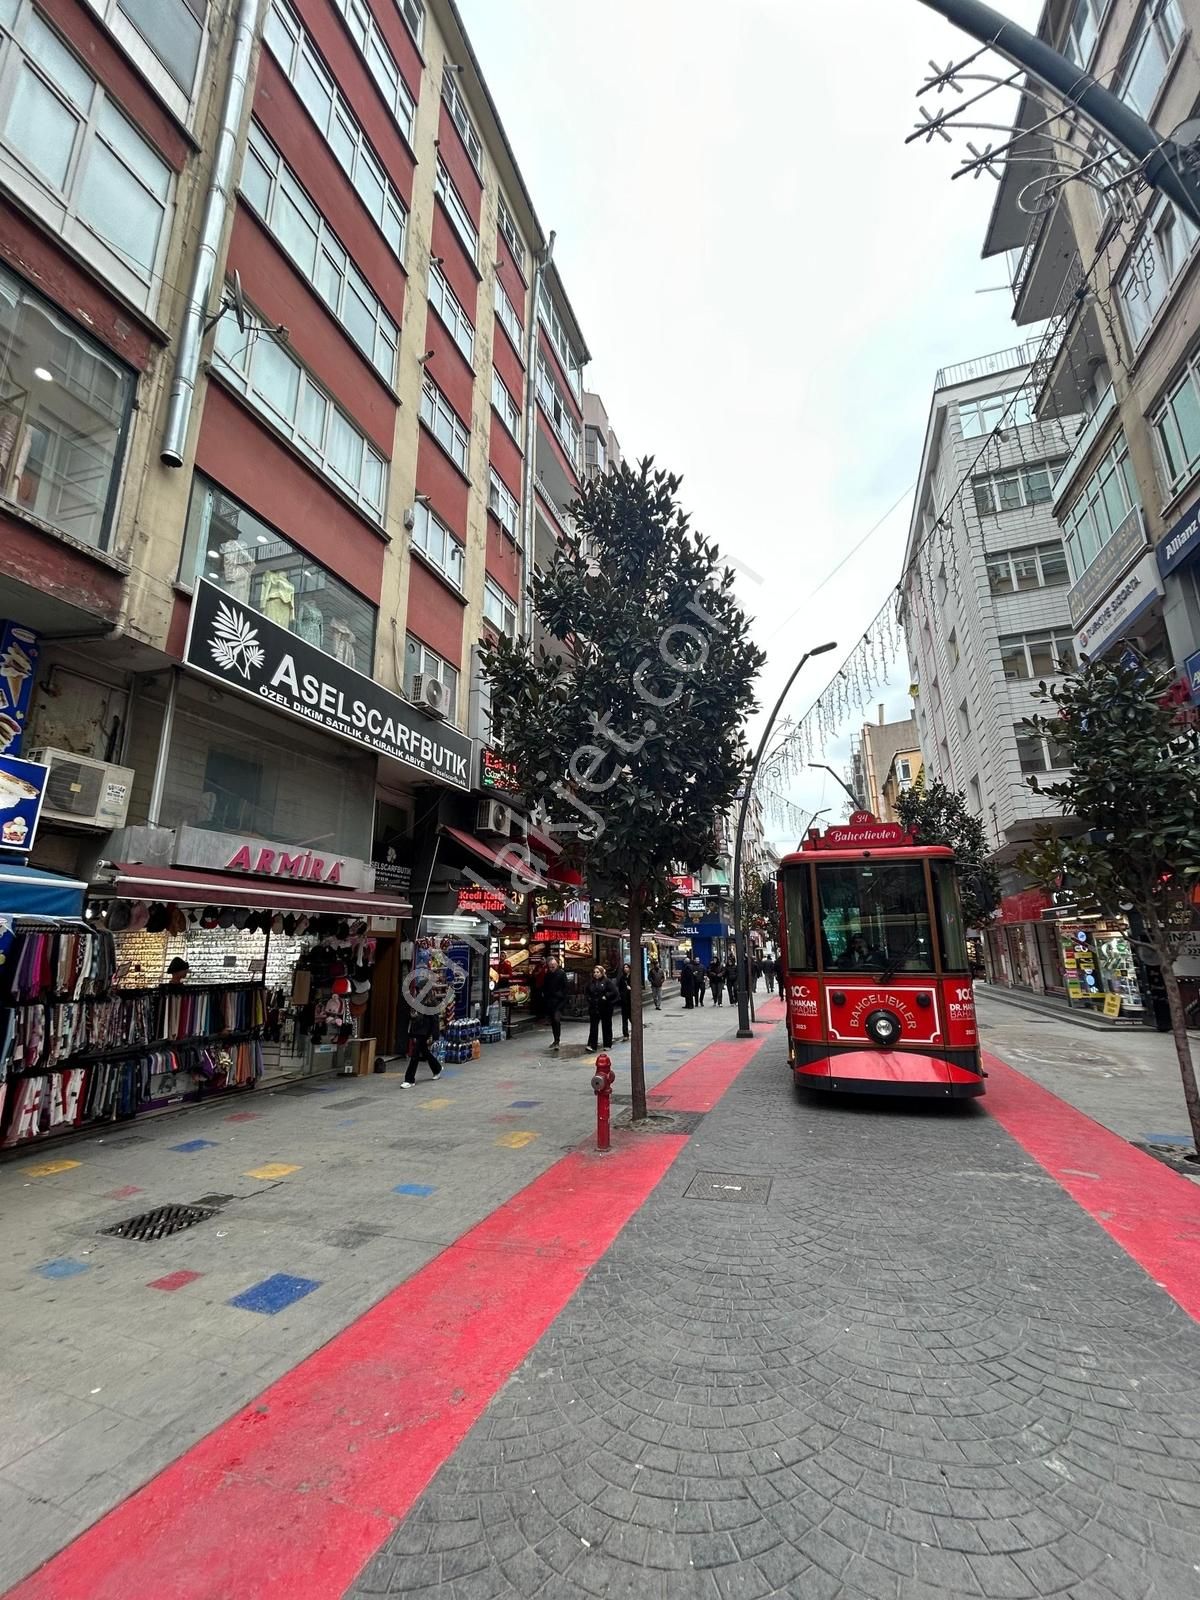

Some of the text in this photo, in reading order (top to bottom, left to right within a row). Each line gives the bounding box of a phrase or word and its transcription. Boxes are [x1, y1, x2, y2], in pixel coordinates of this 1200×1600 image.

[1166, 520, 1198, 560] Allianz
[260, 685, 290, 707] ÖZEL
[326, 716, 362, 739] SATILIK
[364, 734, 371, 742] &
[270, 654, 467, 779] ASELSCARFBUTIK
[856, 814, 868, 823] 34
[224, 845, 341, 884] ARMİRA
[949, 1003, 962, 1011] DR.
